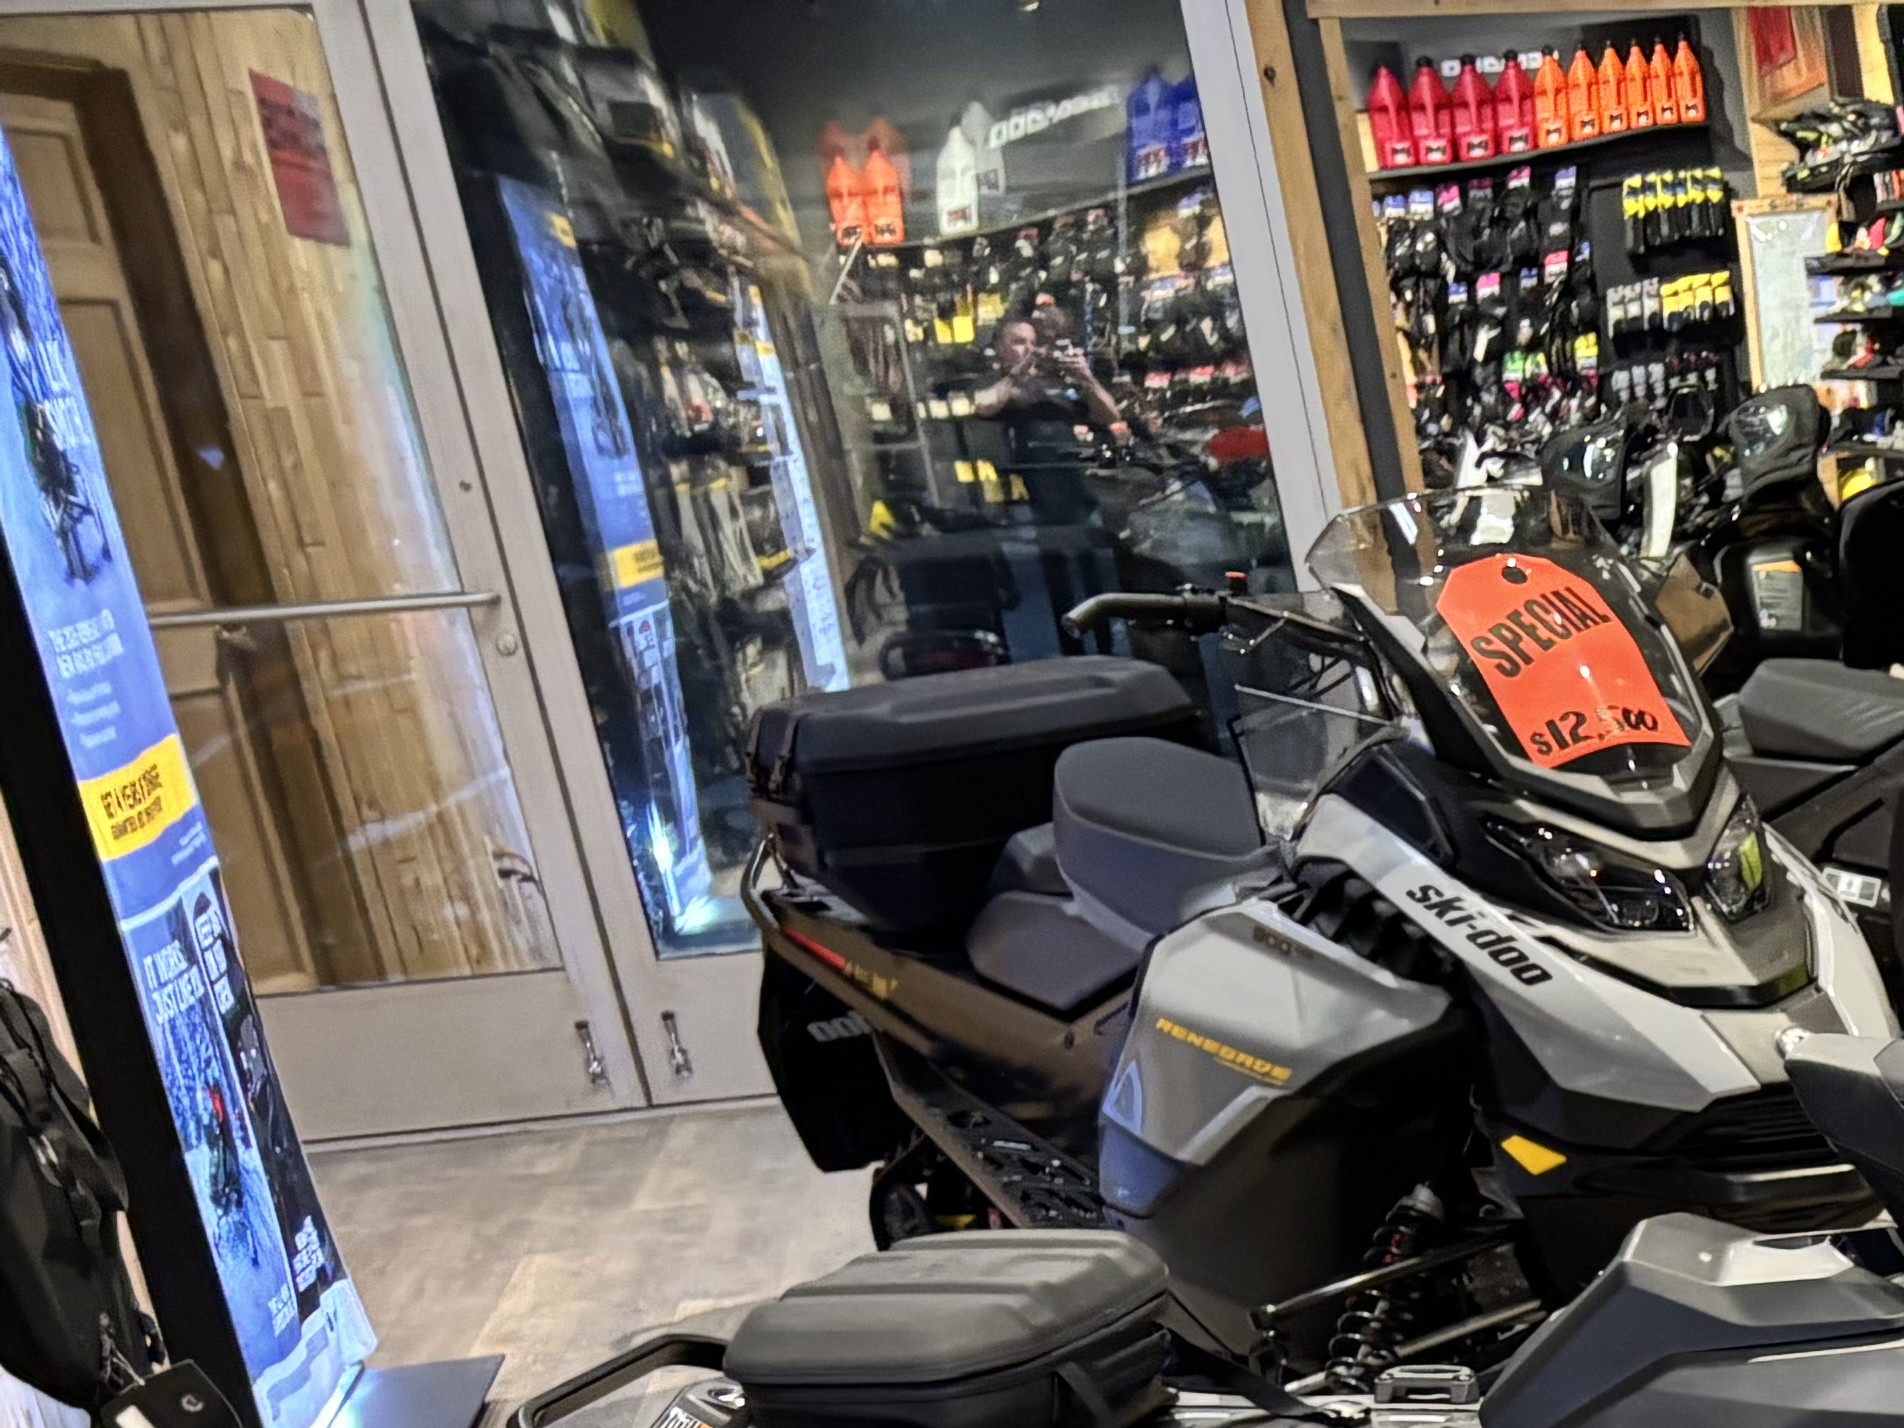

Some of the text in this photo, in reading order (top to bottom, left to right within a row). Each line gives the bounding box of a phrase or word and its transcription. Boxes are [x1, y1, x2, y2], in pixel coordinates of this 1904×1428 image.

[1469, 585, 1614, 680] SPECIAL
[1530, 704, 1659, 757] $12,500
[1404, 882, 1554, 988] ski-doo
[1155, 1016, 1294, 1082] RENEGADE
